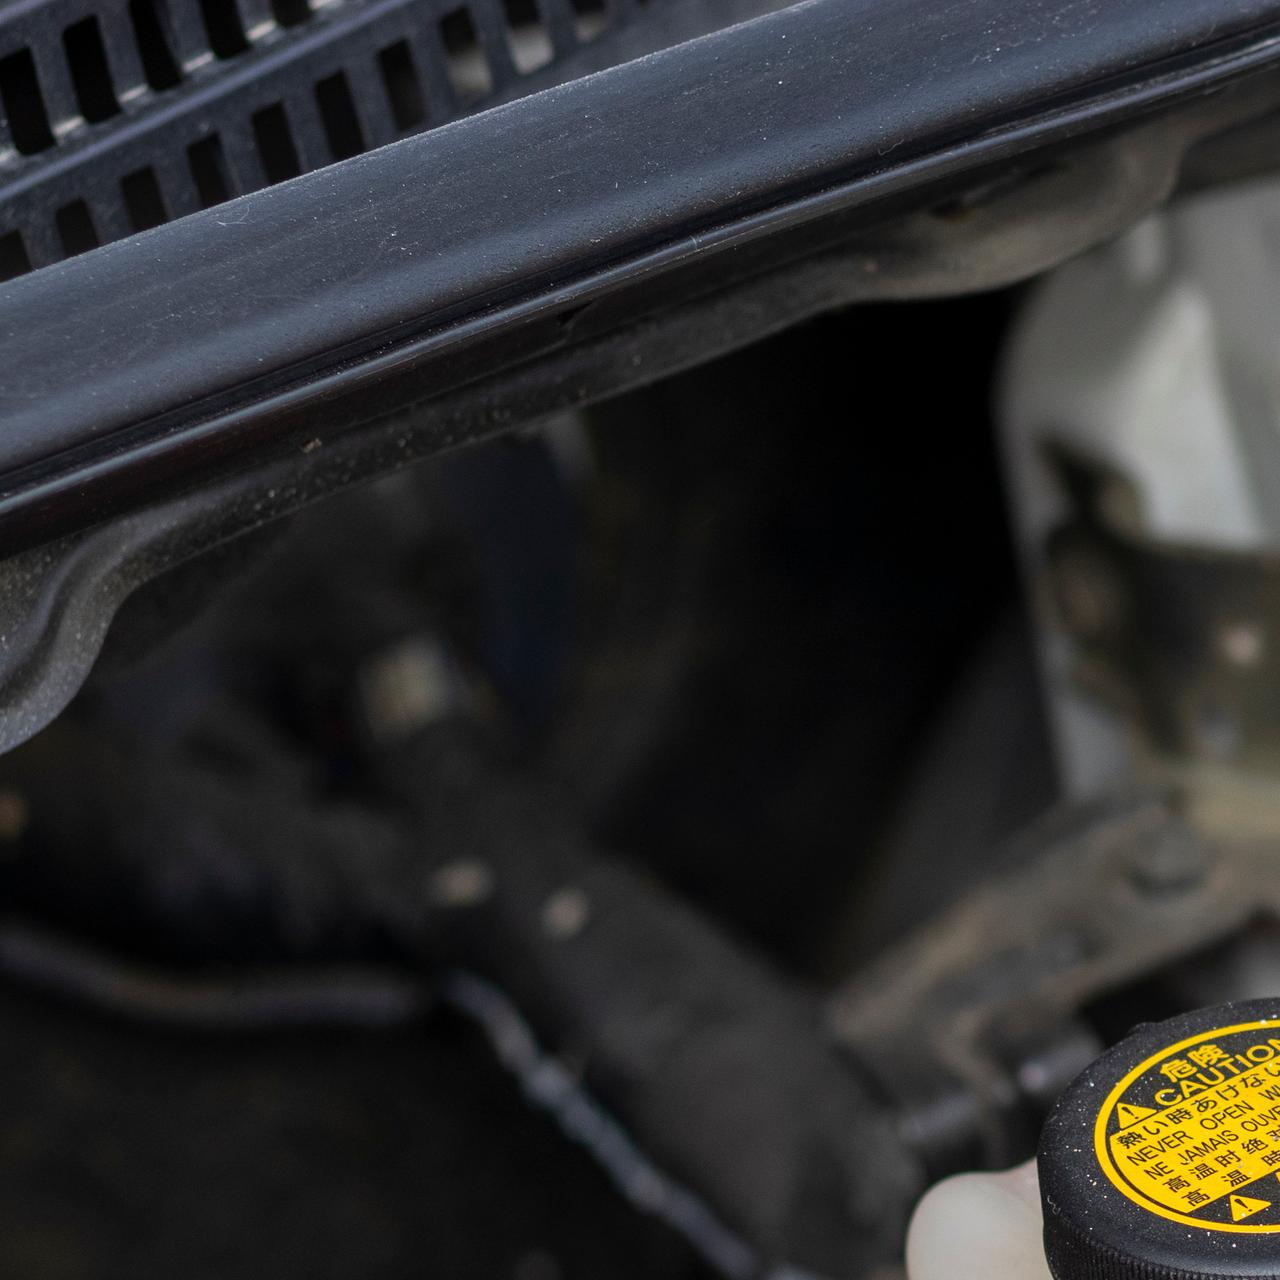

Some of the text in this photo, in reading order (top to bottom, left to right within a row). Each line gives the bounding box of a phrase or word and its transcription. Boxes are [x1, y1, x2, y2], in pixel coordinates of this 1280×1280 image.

[1160, 1044, 1230, 1083] 危険
[1126, 1130, 1194, 1167] NEVER
[1199, 1101, 1255, 1131] OPEN
[1143, 1161, 1175, 1181] NE
[1177, 1129, 1239, 1166] JAMAIS
